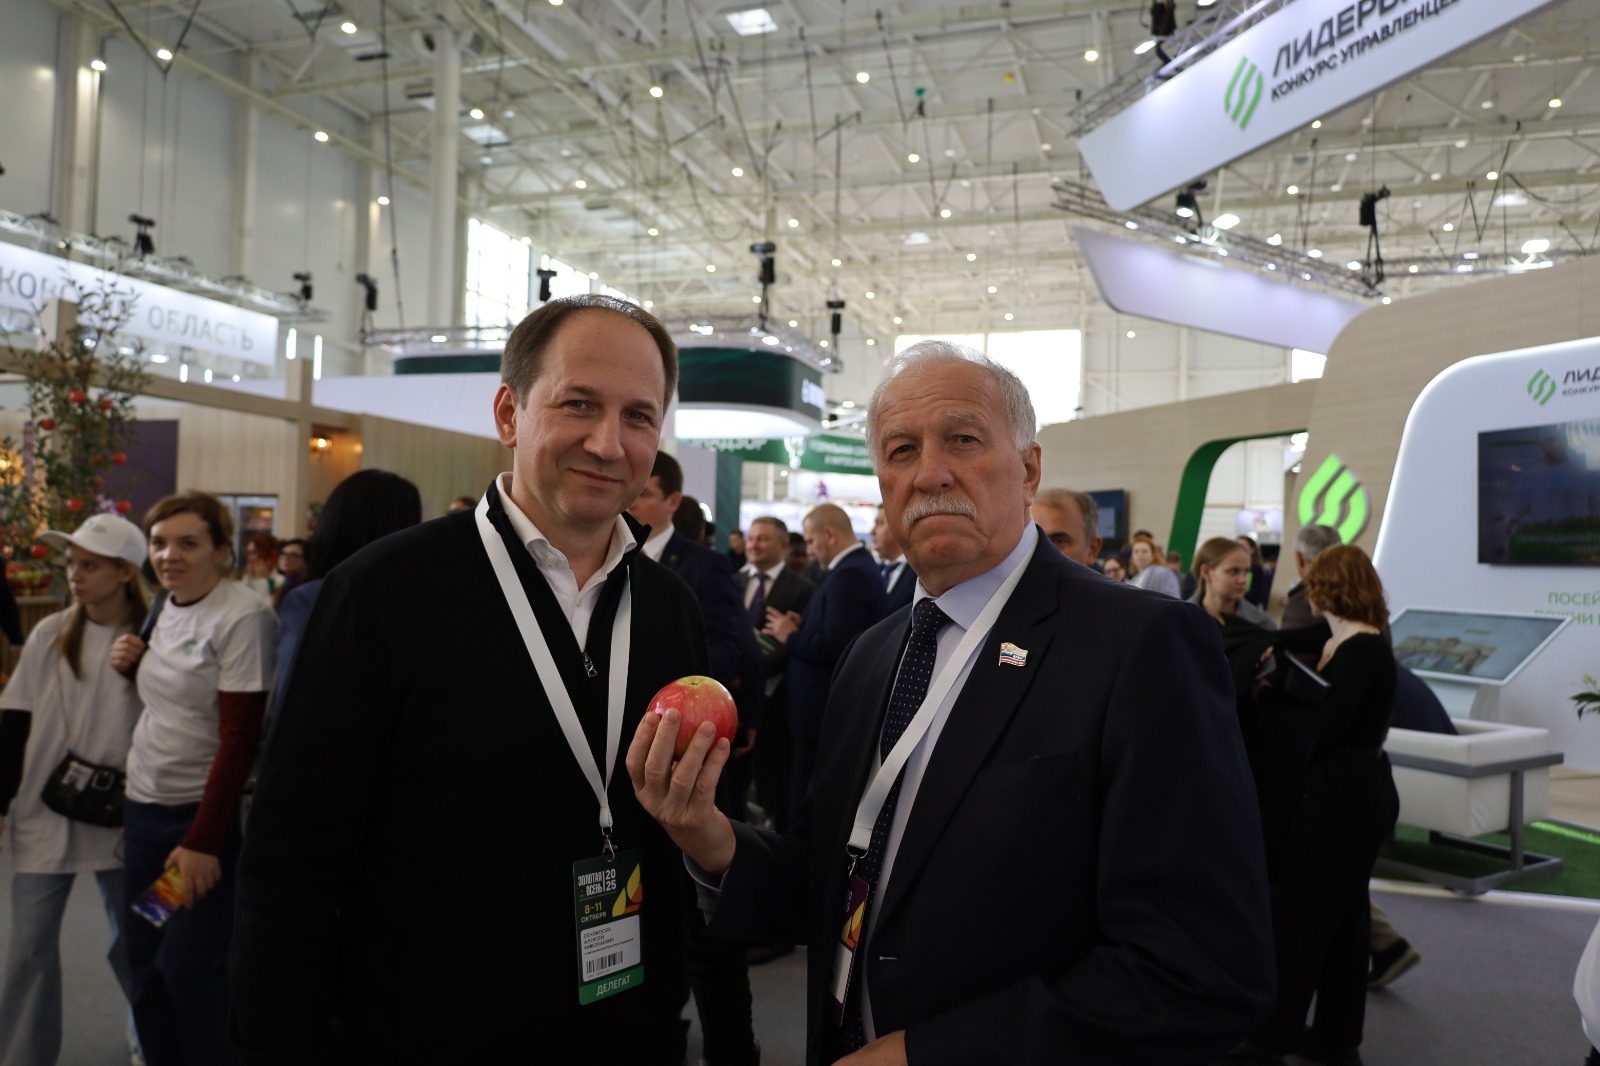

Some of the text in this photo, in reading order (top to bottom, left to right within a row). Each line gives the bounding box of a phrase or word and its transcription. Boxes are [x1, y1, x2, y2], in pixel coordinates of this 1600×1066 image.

[1271, 0, 1460, 101] КОНКУРС УПРАВЛЕНЦЕ
[148, 305, 254, 351] ОБЛАСТЬ
[578, 869, 616, 887] ЗОЛОТАЯ 20
[586, 880, 616, 896] ОСЕНЬ 25
[581, 912, 606, 923] ОКТЯБРЯ
[584, 934, 604, 945] АЛЕКСЕЙ
[584, 938, 614, 950] НИКОЛАЕВИЧ
[597, 975, 630, 996] ДЕЛЕГАТ
